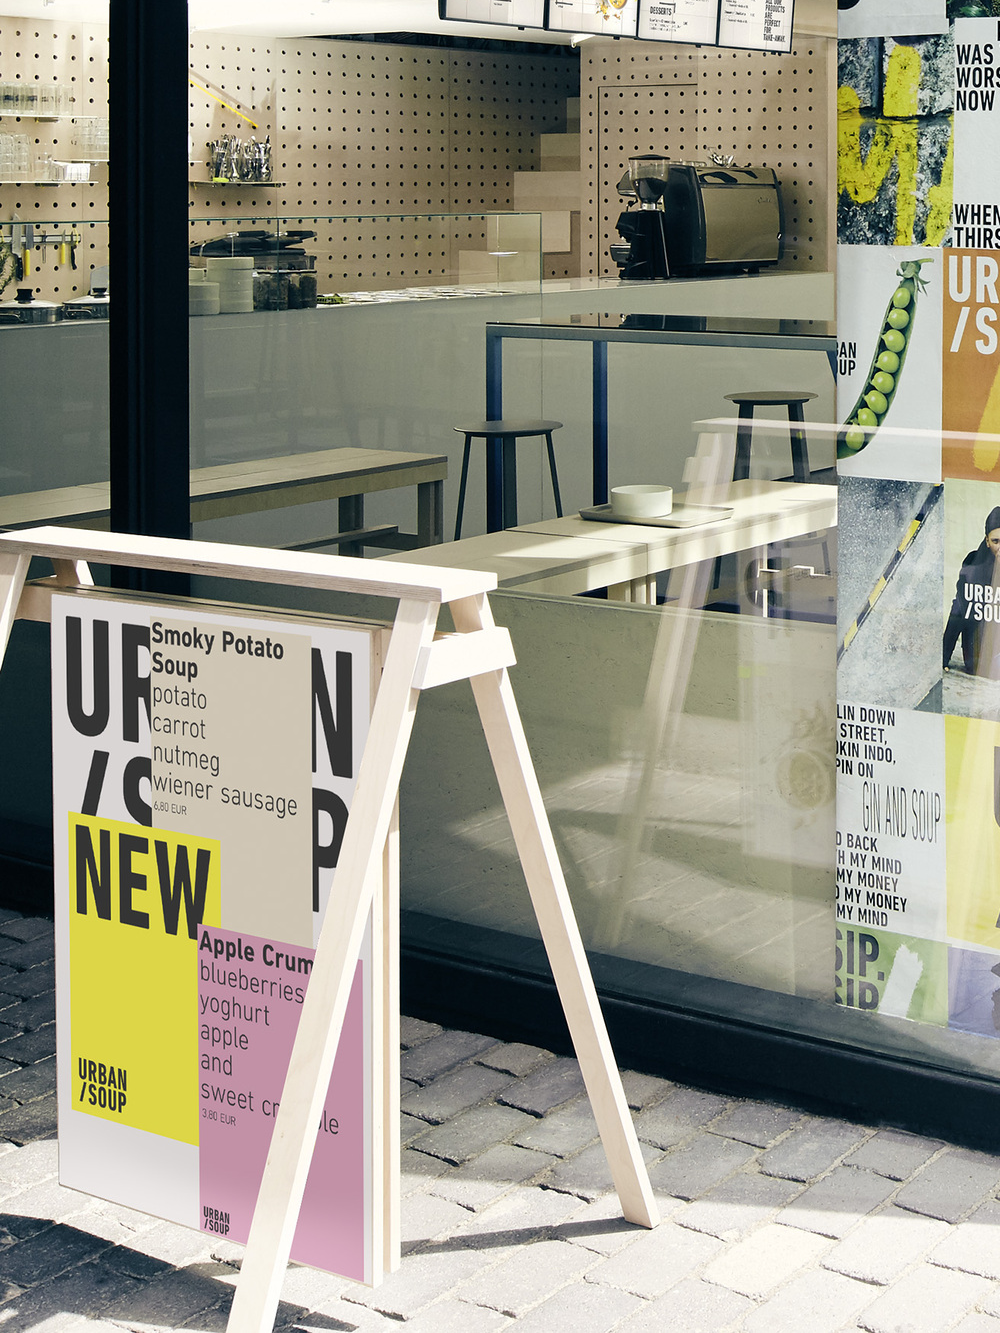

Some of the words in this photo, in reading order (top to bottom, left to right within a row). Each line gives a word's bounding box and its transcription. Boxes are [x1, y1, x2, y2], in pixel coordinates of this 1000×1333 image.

[957, 44, 993, 65] WAS
[152, 621, 214, 655] Smoky
[222, 630, 284, 660] Potato
[152, 652, 198, 682] Soup
[66, 616, 352, 779] URN
[153, 684, 207, 710] potato
[153, 716, 206, 739] carrot
[860, 707, 895, 726] DOWN
[840, 723, 887, 745] STREET,
[153, 745, 220, 776] nutmeg
[153, 773, 213, 800] wiener
[221, 786, 297, 818] sausage
[171, 804, 187, 815] EUR
[862, 781, 880, 832] GIN
[885, 785, 907, 838] AND
[911, 788, 941, 844] SOUP
[847, 833, 878, 852] BACK
[75, 824, 211, 940] NEW
[857, 873, 898, 892] MONEY
[200, 930, 255, 963] Apple
[200, 959, 305, 1004] blueberries
[200, 993, 270, 1026] yoghurt
[200, 1022, 249, 1050] apple
[78, 1057, 127, 1091] URBAN
[201, 1052, 233, 1076] and
[79, 1081, 127, 1113] /SOUP
[201, 1082, 254, 1112] sweet
[262, 1098, 339, 1136] crle
[220, 1112, 236, 1127] EUR
[203, 1206, 230, 1224] URBAN
[204, 1218, 230, 1236] /SOUP
